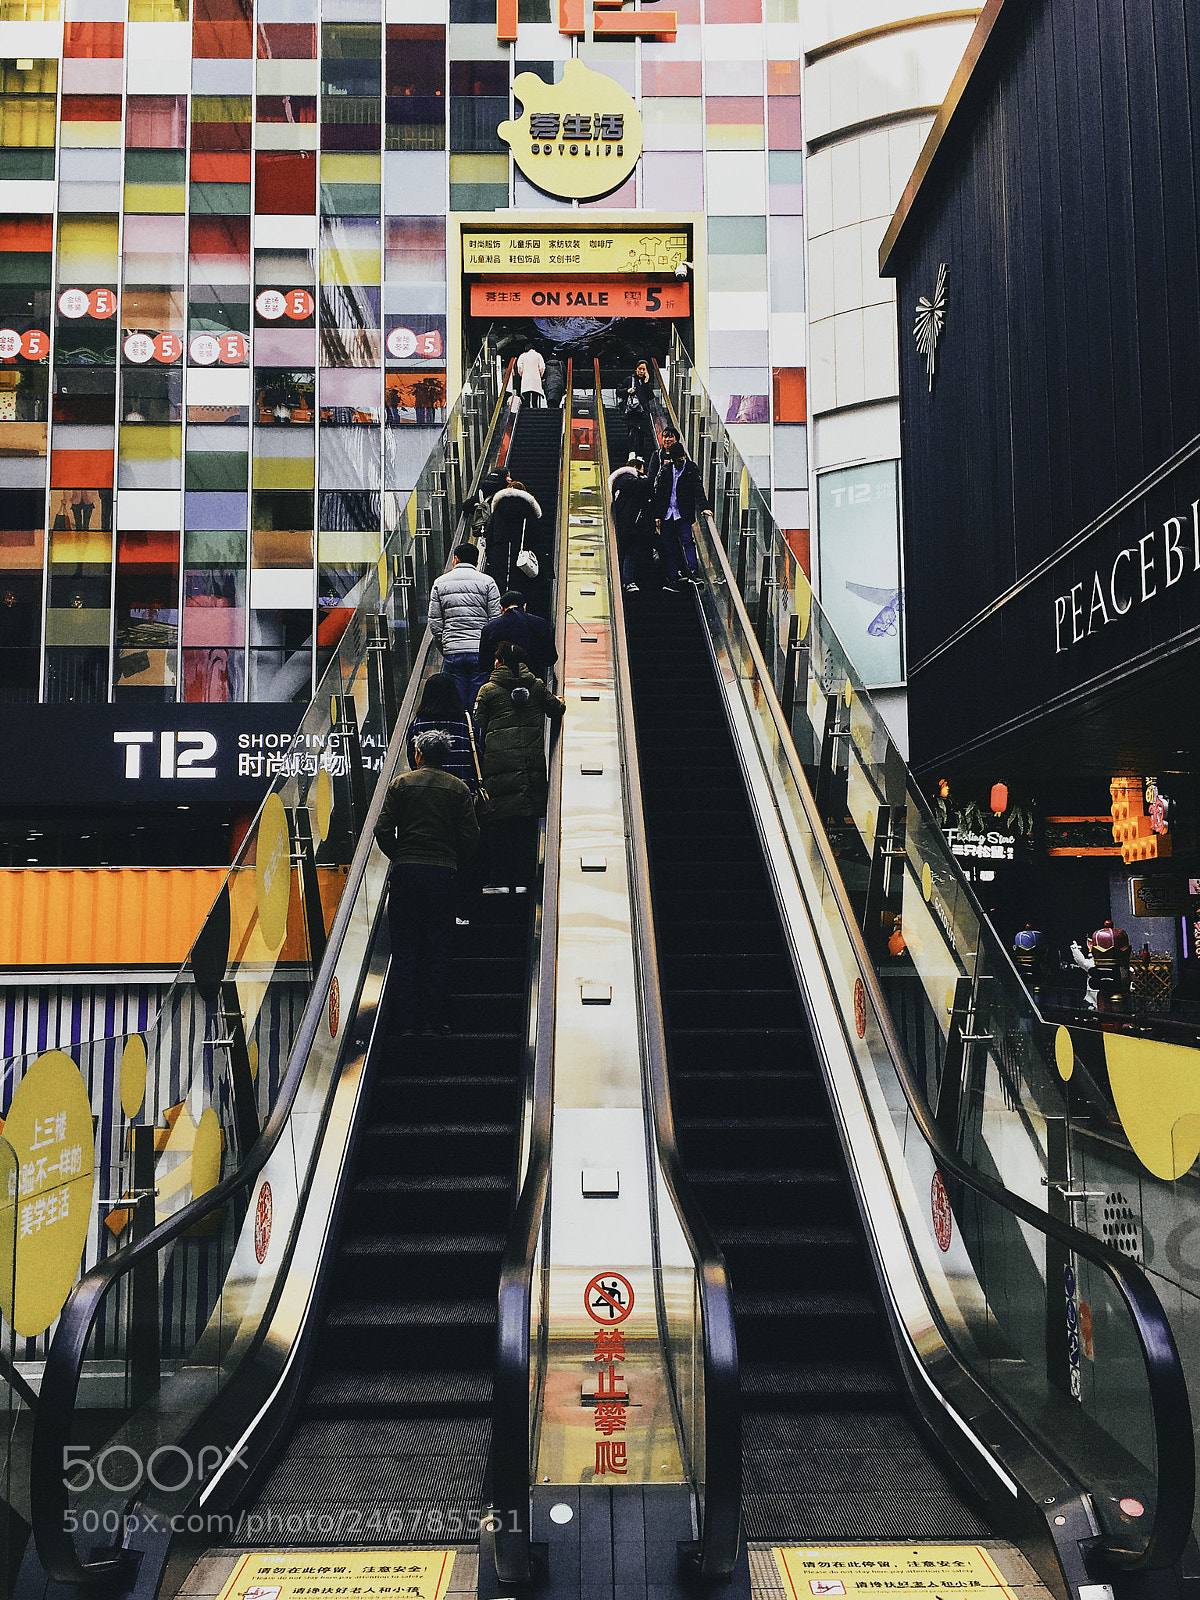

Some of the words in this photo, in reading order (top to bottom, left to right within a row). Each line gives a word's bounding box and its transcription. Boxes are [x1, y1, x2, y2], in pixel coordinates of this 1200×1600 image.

[530, 113, 624, 140] 荟生活
[531, 144, 623, 156] GOTOLIFE
[469, 239, 501, 248] 时尚服饰
[509, 239, 541, 248] 儿童乐园
[548, 239, 581, 249] 家纺软装
[589, 239, 614, 248] 咖啡厅
[509, 254, 541, 264] 鞋包饰品
[548, 254, 581, 264] 文创书吧
[485, 291, 521, 302] 荟生活
[531, 291, 561, 306] ON
[565, 291, 609, 306] SALE
[645, 287, 662, 312] 5
[96, 298, 107, 313] 5
[293, 298, 304, 314] 5
[28, 338, 40, 354] 5
[161, 341, 172, 357] 5
[227, 342, 238, 358] 5
[424, 337, 435, 353] 5
[237, 733, 341, 748] SHOPPING
[20, 1187, 69, 1239] 美学生活
[593, 1328, 628, 1475] 禁止攀爬
